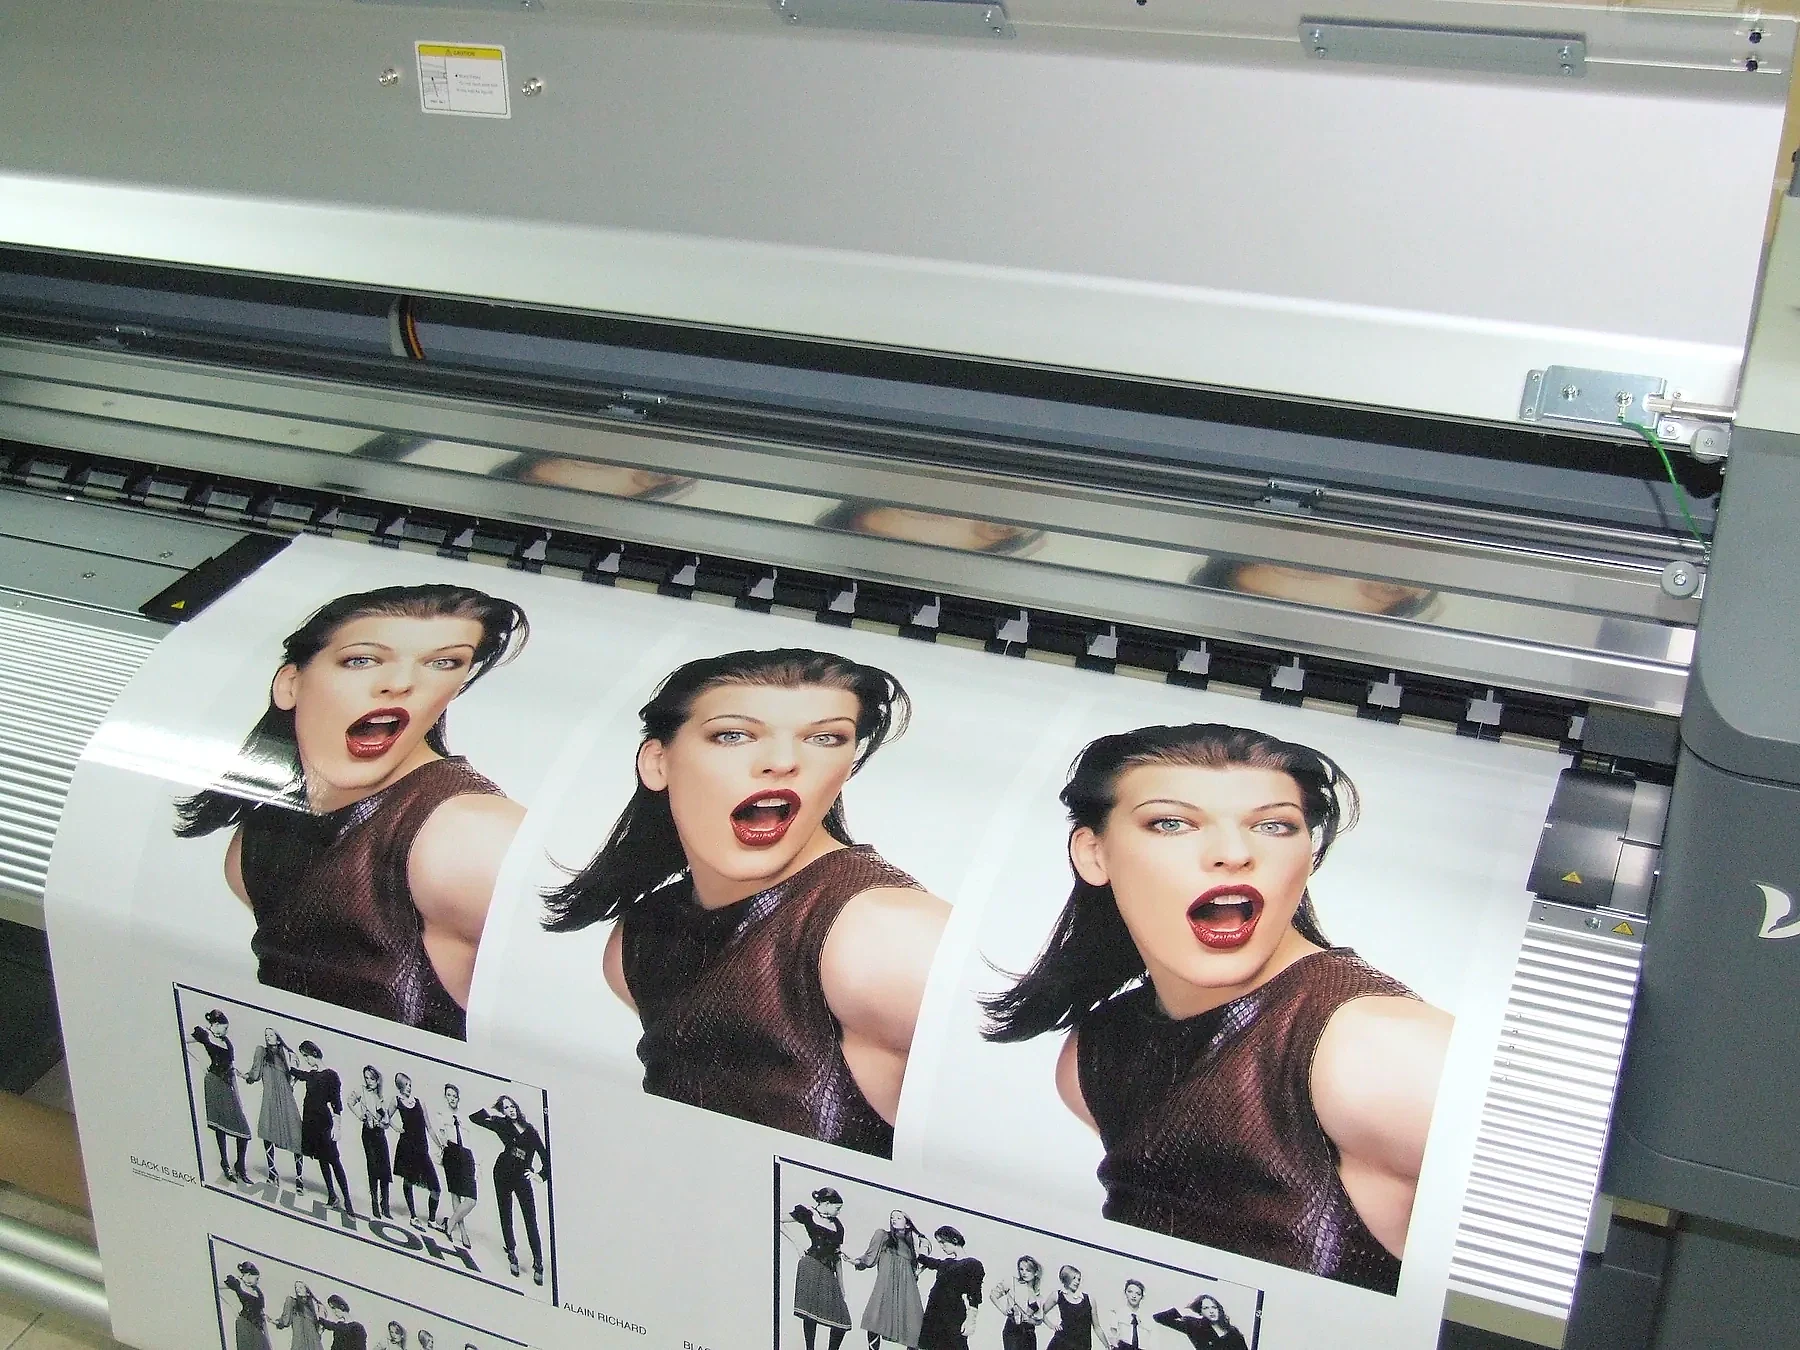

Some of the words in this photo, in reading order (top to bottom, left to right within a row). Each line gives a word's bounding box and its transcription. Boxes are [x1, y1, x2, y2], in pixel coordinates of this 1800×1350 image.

[130, 1155, 160, 1172] BLACK
[161, 1165, 170, 1176] IS
[171, 1169, 197, 1185] BACK
[215, 1176, 481, 1273] MUTOH
[563, 1302, 595, 1319] ALAIN
[597, 1312, 647, 1336] RICHARD
